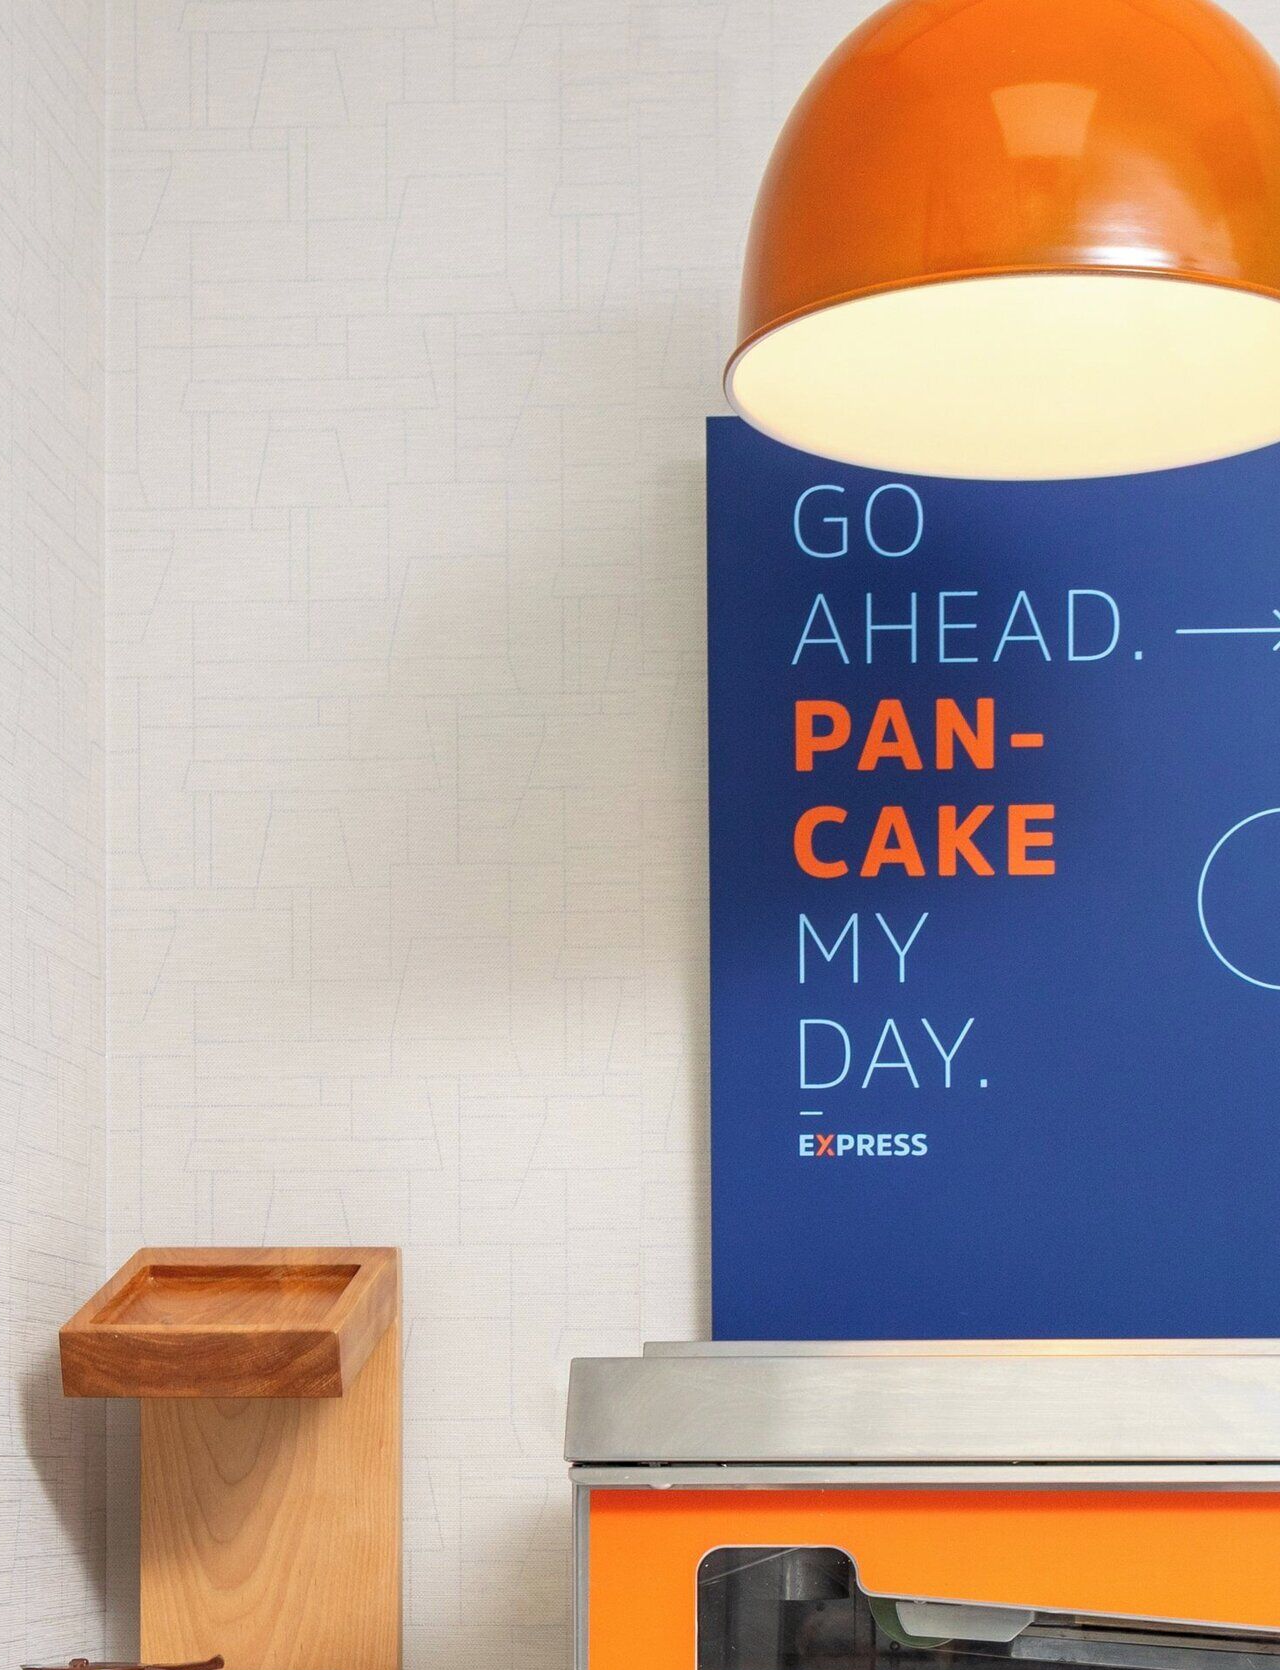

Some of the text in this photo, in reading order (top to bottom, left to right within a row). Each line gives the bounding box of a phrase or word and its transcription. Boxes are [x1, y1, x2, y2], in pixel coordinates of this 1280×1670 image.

[793, 483, 924, 558] GO
[791, 589, 1144, 665] AHEAD.
[794, 698, 1044, 772] PAN-
[793, 804, 1056, 879] CAKE
[799, 912, 929, 984] MY
[799, 1017, 988, 1089] DAY.
[799, 1133, 928, 1157] EXPRESS
